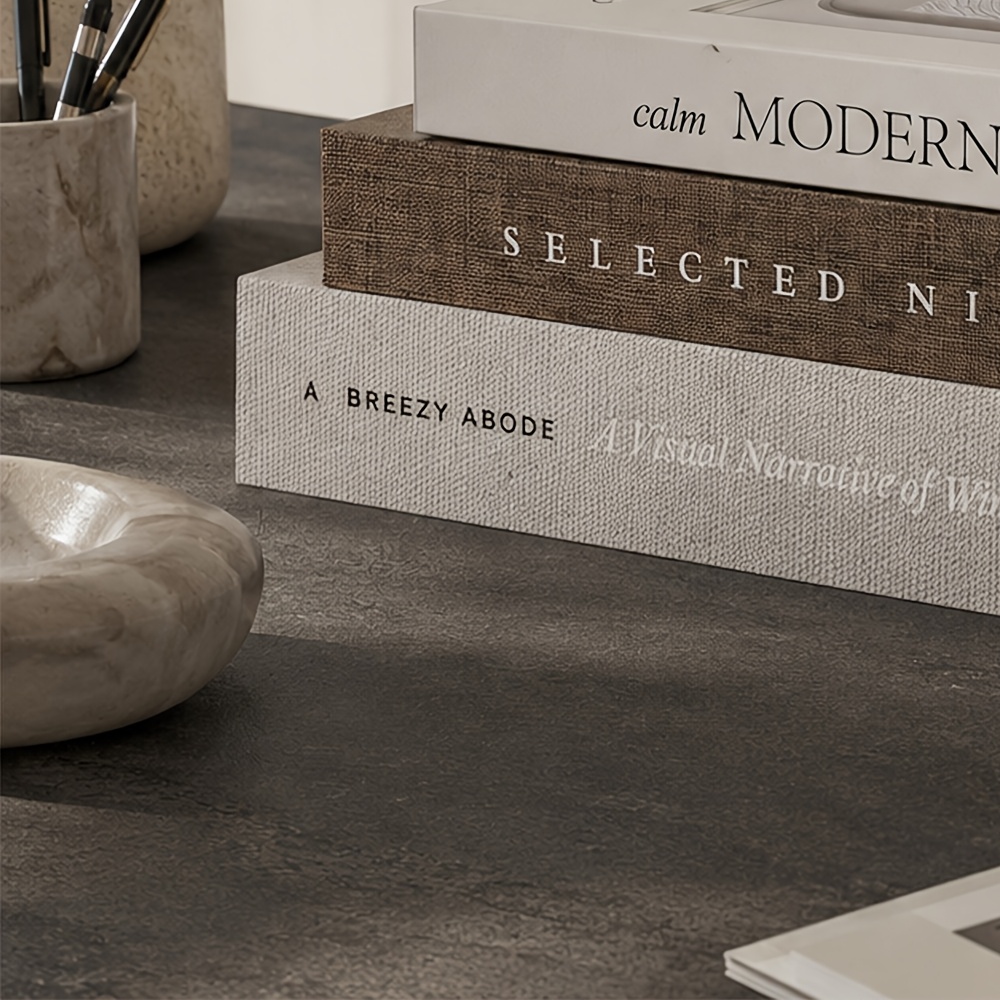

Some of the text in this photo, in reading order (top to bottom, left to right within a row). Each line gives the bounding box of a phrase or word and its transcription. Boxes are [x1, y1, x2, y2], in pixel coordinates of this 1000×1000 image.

[632, 97, 707, 135] calm
[502, 225, 846, 303] SELECTED
[303, 380, 554, 441] A BREEZY ABODE
[591, 417, 617, 454] A
[632, 419, 729, 473] Visual
[736, 438, 896, 498] Narrative
[901, 467, 938, 515] of
